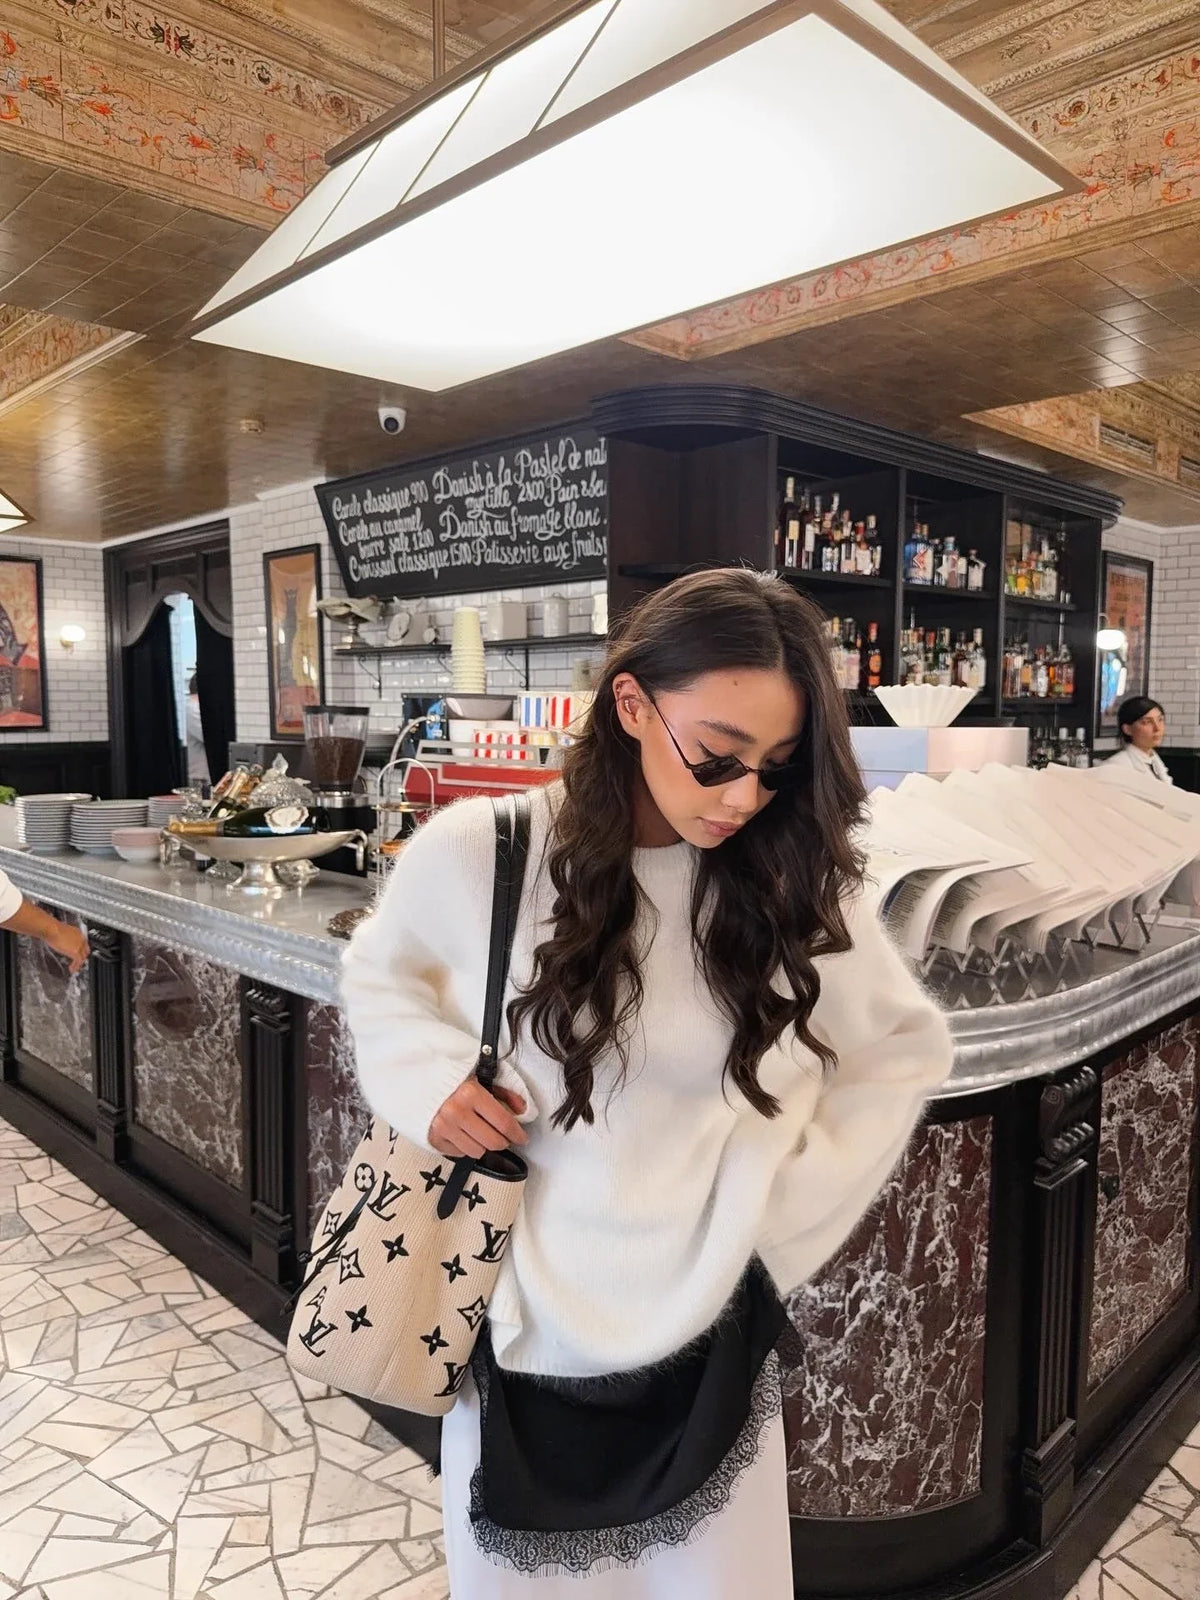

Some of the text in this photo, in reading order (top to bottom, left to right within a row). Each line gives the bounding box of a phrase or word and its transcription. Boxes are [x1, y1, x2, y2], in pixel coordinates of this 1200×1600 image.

[513, 439, 567, 485] Pastel
[565, 437, 582, 470] de
[432, 461, 484, 504] Danish
[498, 456, 513, 488] la
[544, 472, 580, 507] Pain
[363, 487, 411, 517] classique
[382, 507, 424, 535] caramel
[439, 500, 601, 542] Danish au fromage blanc
[349, 553, 398, 582] Croissant
[398, 549, 450, 579] classique
